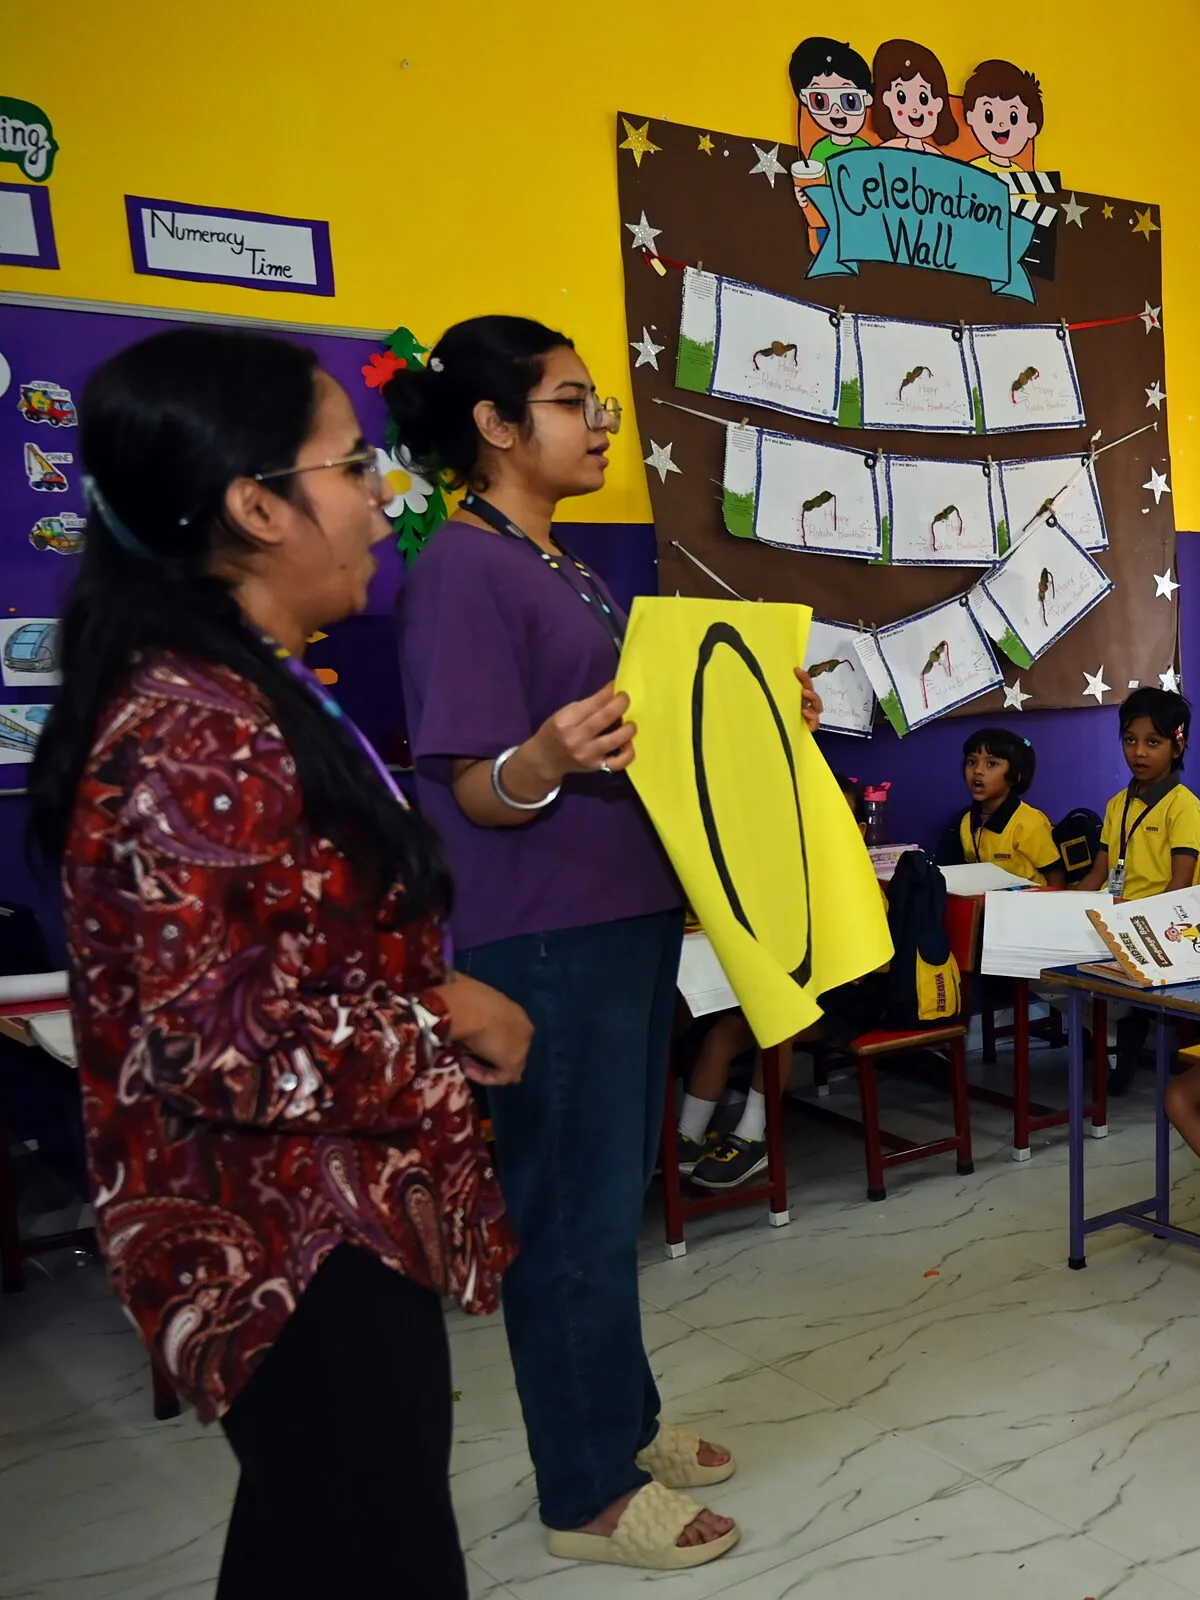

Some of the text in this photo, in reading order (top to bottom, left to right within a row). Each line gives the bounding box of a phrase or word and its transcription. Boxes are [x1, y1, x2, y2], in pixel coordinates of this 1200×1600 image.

[837, 161, 1003, 231] Celebration
[151, 209, 245, 255] Numeracy
[882, 212, 957, 270] Wall
[245, 248, 293, 278] Time
[1133, 919, 1148, 936] Book
[1119, 932, 1149, 965] KIDZEE
[1145, 936, 1169, 965] Language
[935, 973, 946, 1012] KIDZEE
